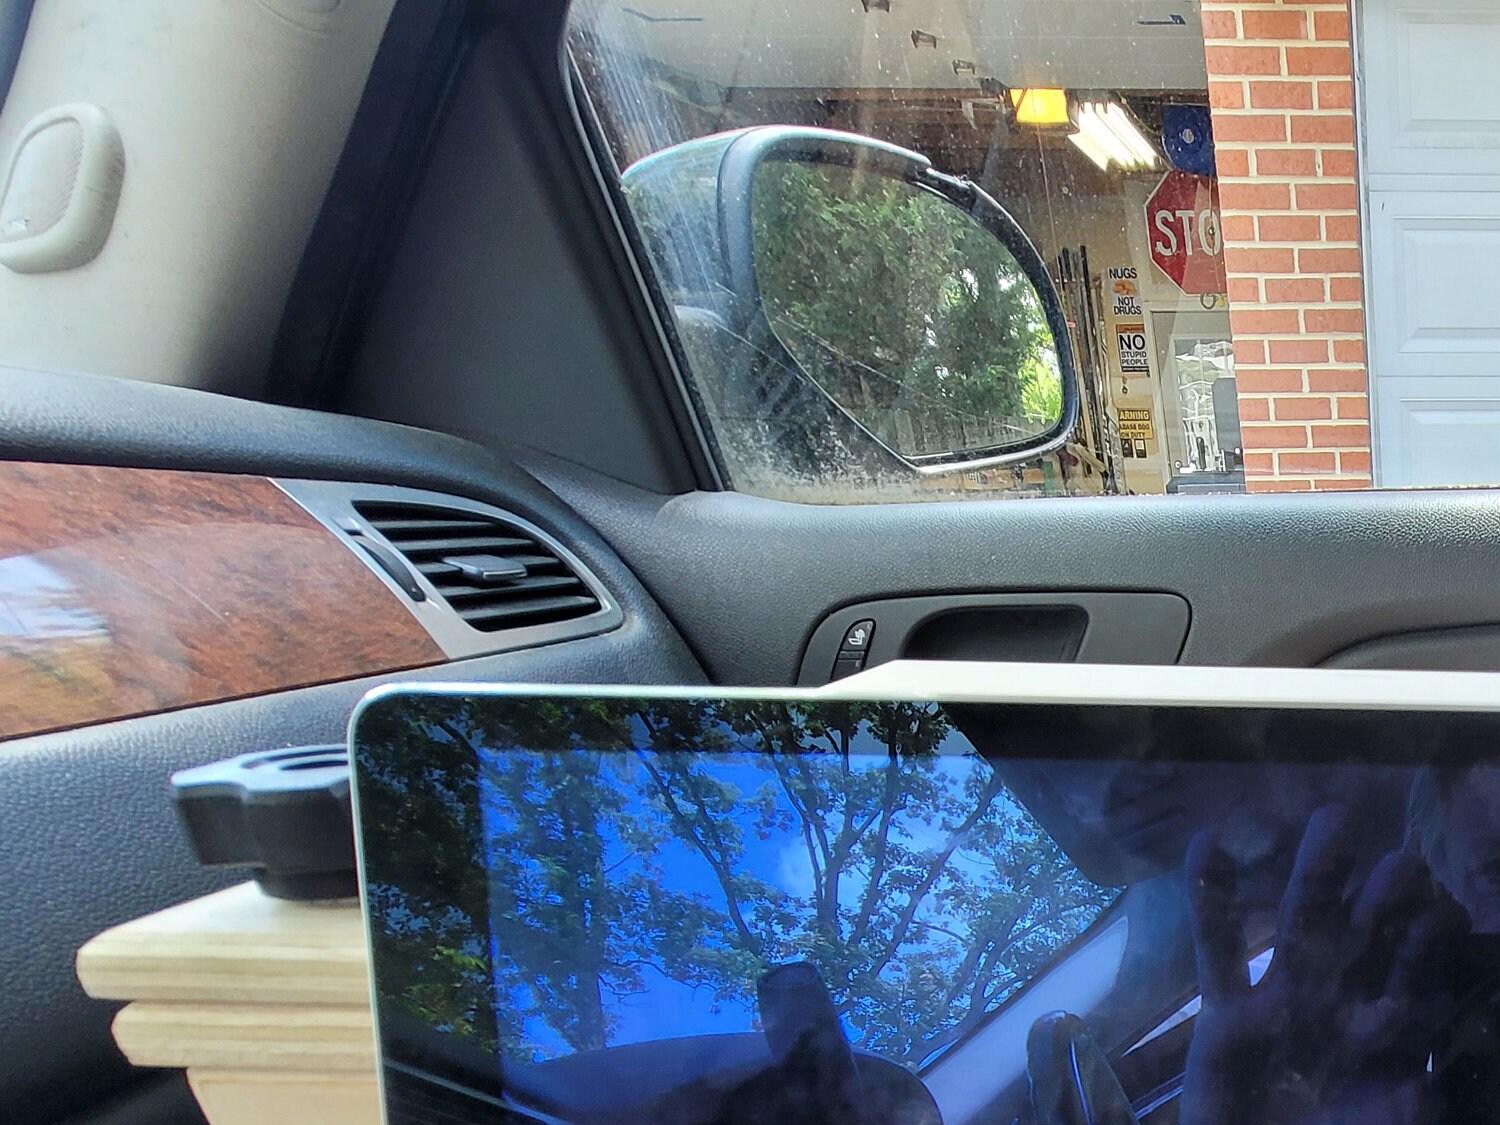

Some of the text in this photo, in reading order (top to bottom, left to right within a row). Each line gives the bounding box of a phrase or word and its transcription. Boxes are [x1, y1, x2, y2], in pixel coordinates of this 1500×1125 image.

[1155, 209, 1222, 258] STO
[1108, 267, 1138, 279] NUGS
[1117, 296, 1135, 306] NOT
[1113, 305, 1142, 315] DRUGS
[1119, 334, 1146, 351] NO
[1120, 411, 1149, 420] ARNING
